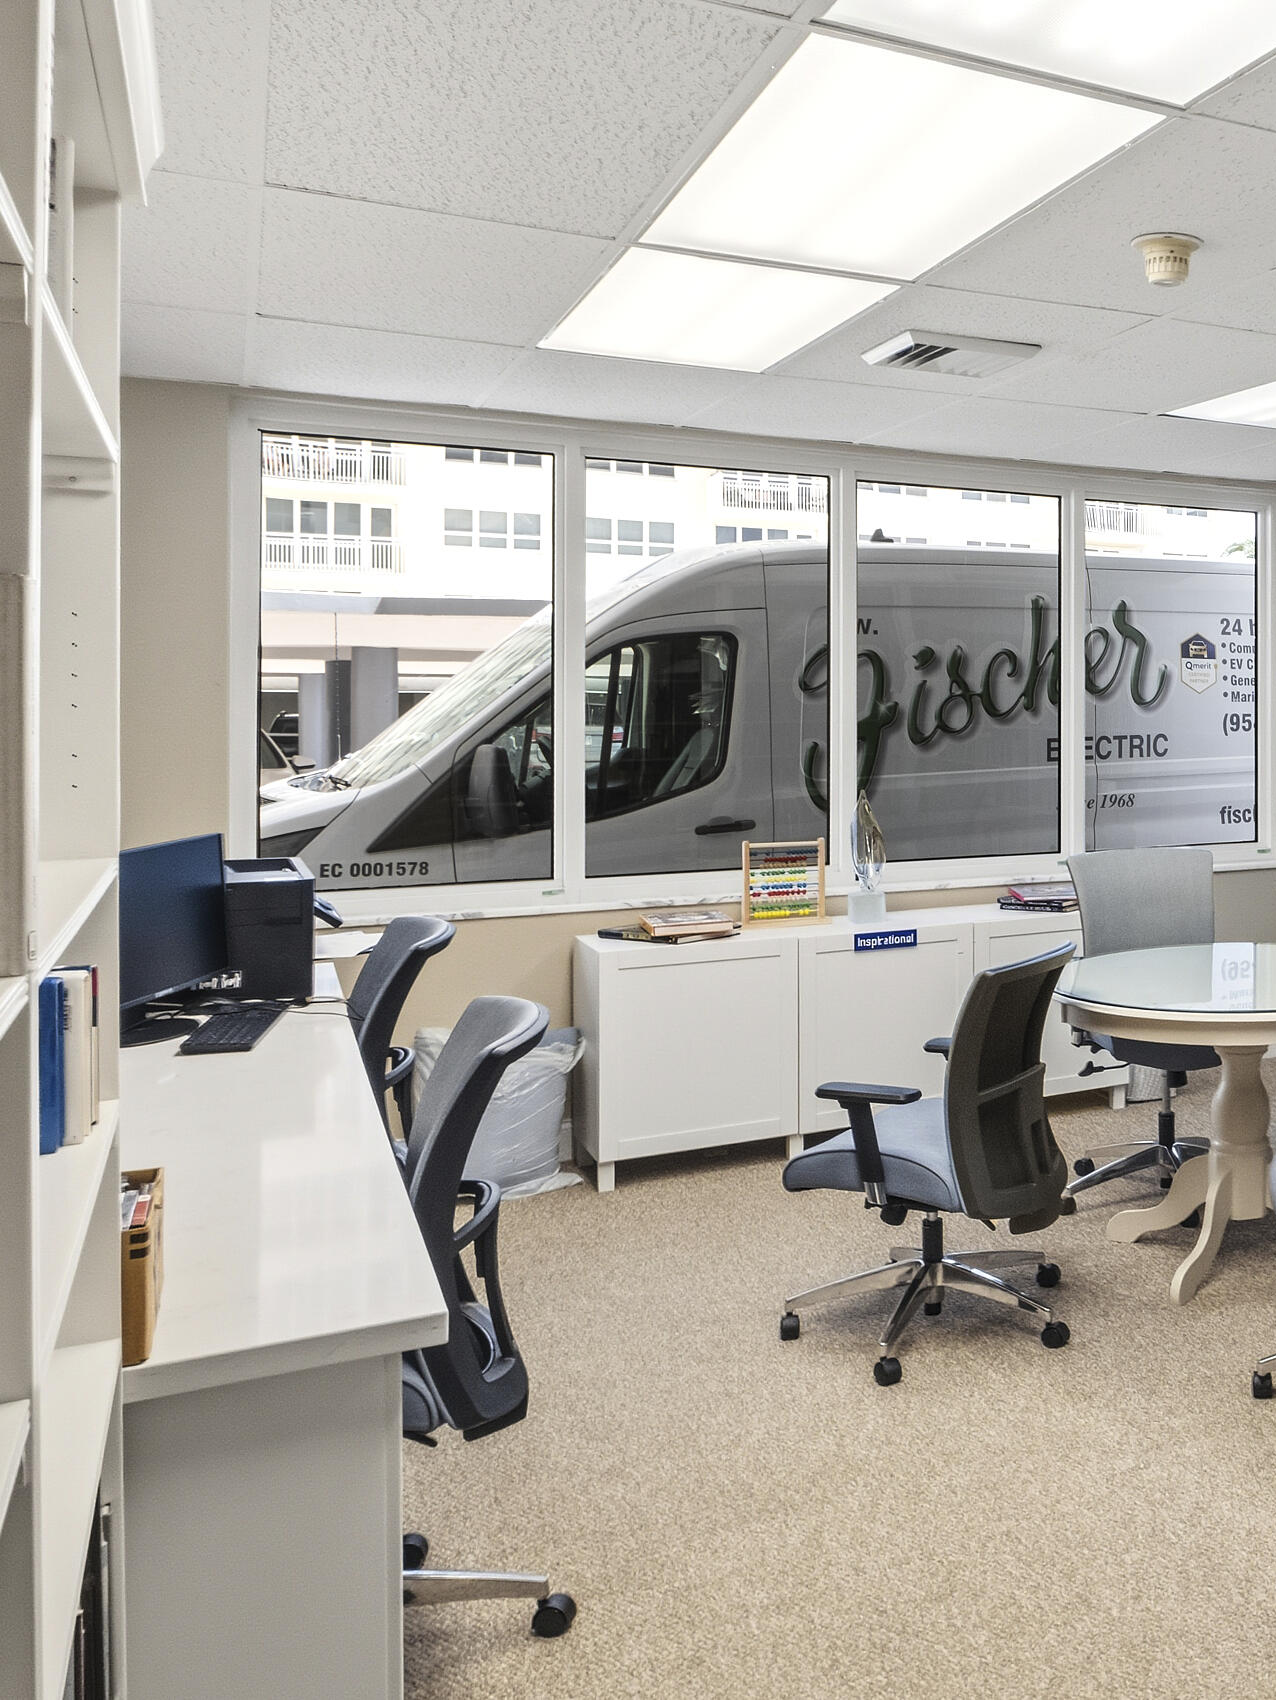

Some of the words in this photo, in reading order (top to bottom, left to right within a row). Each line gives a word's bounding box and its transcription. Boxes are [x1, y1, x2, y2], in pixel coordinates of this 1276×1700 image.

[1220, 618, 1243, 636] 24
[1185, 661, 1212, 671] Qmerit
[1230, 658, 1243, 669] EV
[1231, 691, 1255, 702] Mari
[1223, 713, 1255, 736] (95
[1046, 733, 1169, 762] EECTRIC
[1100, 793, 1135, 809] 1968
[320, 863, 343, 878] EC
[349, 861, 430, 878] 0001578
